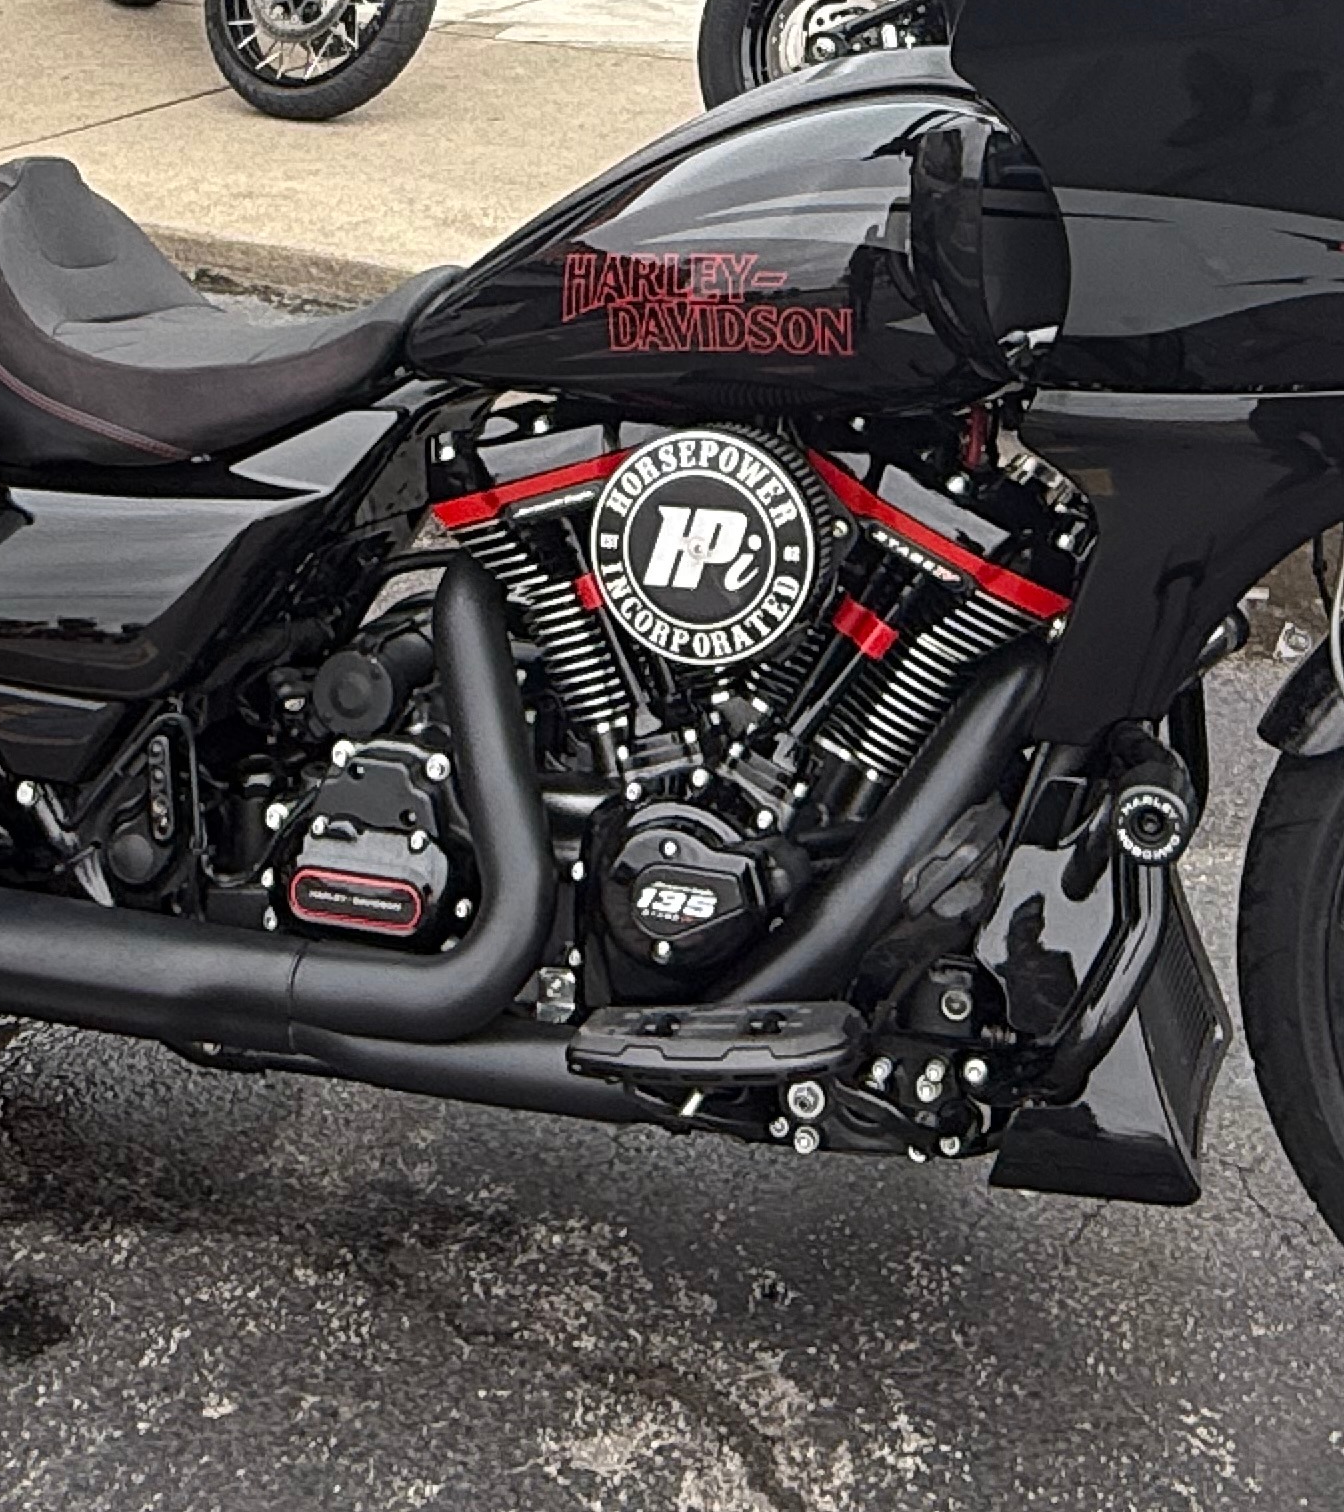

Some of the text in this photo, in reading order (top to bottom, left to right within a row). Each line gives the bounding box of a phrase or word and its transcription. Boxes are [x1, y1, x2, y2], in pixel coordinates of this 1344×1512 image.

[608, 303, 854, 355] DAVIDSON
[606, 439, 799, 529] HORSEPOWER
[601, 560, 801, 658] INCORPORATED
[636, 887, 718, 919] 135
